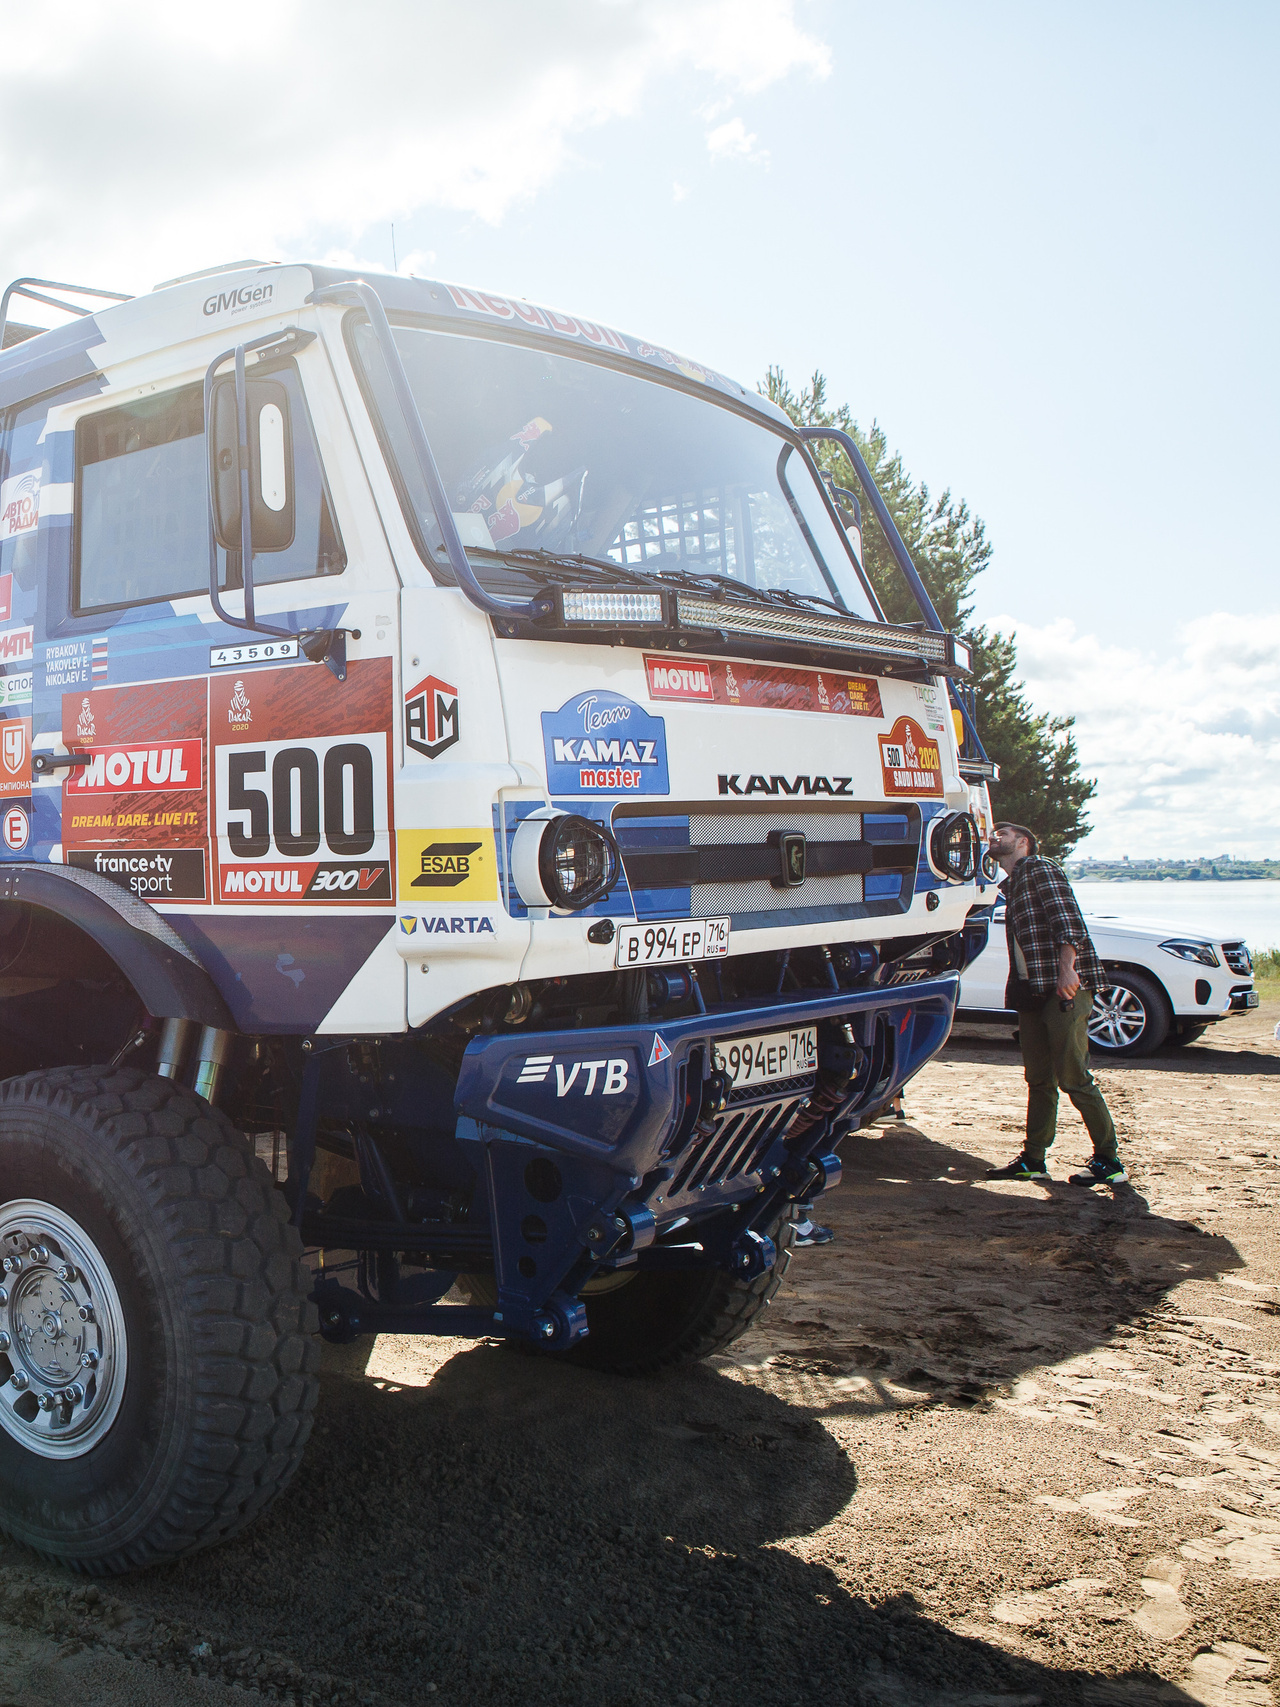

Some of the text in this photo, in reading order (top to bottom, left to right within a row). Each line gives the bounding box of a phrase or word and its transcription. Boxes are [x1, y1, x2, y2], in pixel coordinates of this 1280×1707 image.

[203, 284, 273, 316] GMGen
[46, 642, 87, 659] RYBAKOV V.
[217, 644, 291, 662] 43509
[46, 656, 90, 673] YAKOVLEV E.
[46, 670, 88, 686] NIKOLAEV E.
[654, 667, 709, 692] MOTUL
[578, 696, 631, 733] Team
[232, 723, 249, 731] 2020
[552, 738, 657, 764] KAMAZ
[887, 746, 939, 769] 500 2020
[77, 748, 188, 787] MOTUL
[580, 766, 641, 787] master
[718, 774, 853, 795] KAMAZ
[893, 770, 935, 788] SAUDI ARABIA
[227, 744, 375, 857] 500
[71, 812, 198, 827] DREAM. DARE. LIVE IT.
[421, 857, 469, 873] ESAB
[130, 874, 173, 897] sport
[224, 868, 384, 892] MOTUL 300V
[422, 917, 494, 933] VARTA
[709, 923, 725, 942] 716
[707, 945, 719, 954] RUS
[791, 1031, 813, 1060] 716
[796, 1058, 808, 1069] RUS
[554, 1059, 629, 1097] VTB
